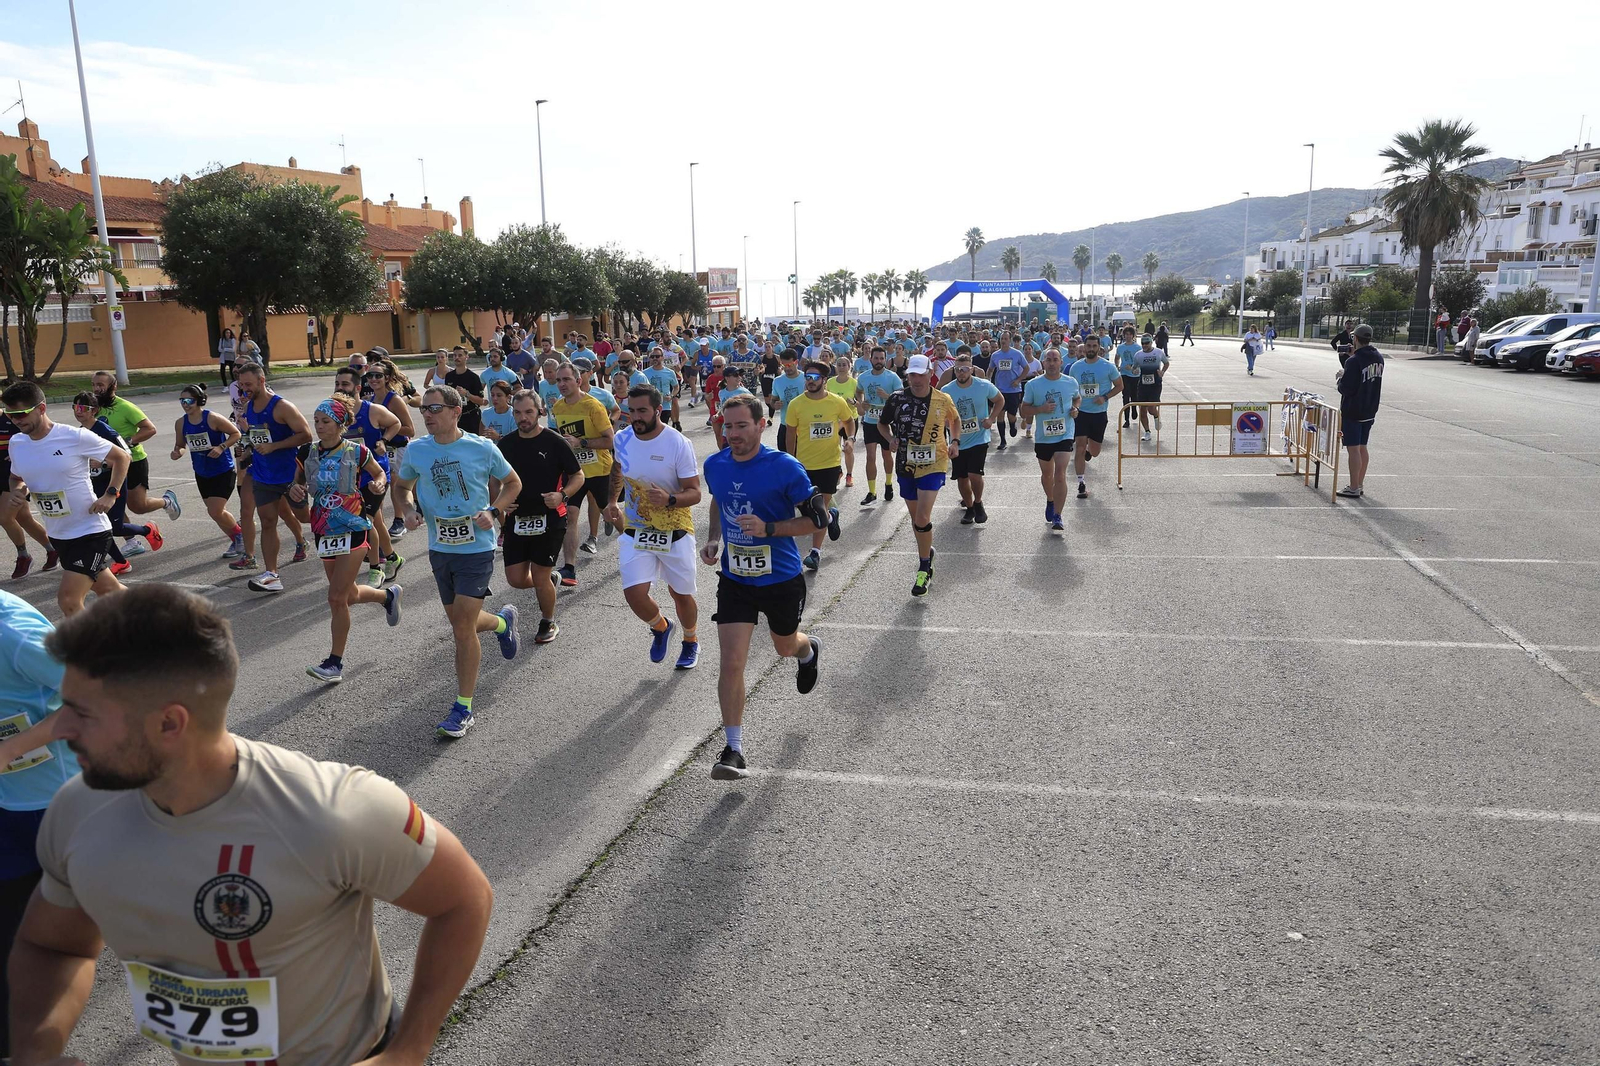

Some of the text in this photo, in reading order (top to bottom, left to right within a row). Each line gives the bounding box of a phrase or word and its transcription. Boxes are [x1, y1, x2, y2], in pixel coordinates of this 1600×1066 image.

[813, 427, 832, 436] 409
[1046, 423, 1063, 431] 456
[189, 438, 208, 447] 108
[251, 435, 269, 444] 335
[910, 451, 932, 459] 131
[37, 500, 63, 511] 191
[518, 519, 543, 530] 249
[439, 525, 469, 537] 298
[321, 537, 346, 550] 141
[638, 532, 668, 545] 245
[732, 554, 766, 568] 115
[148, 973, 195, 996] CARRERA
[197, 988, 247, 997] URBANA
[149, 984, 249, 1006] CIUDAD DE ALGECIRAS
[145, 992, 259, 1038] 279
